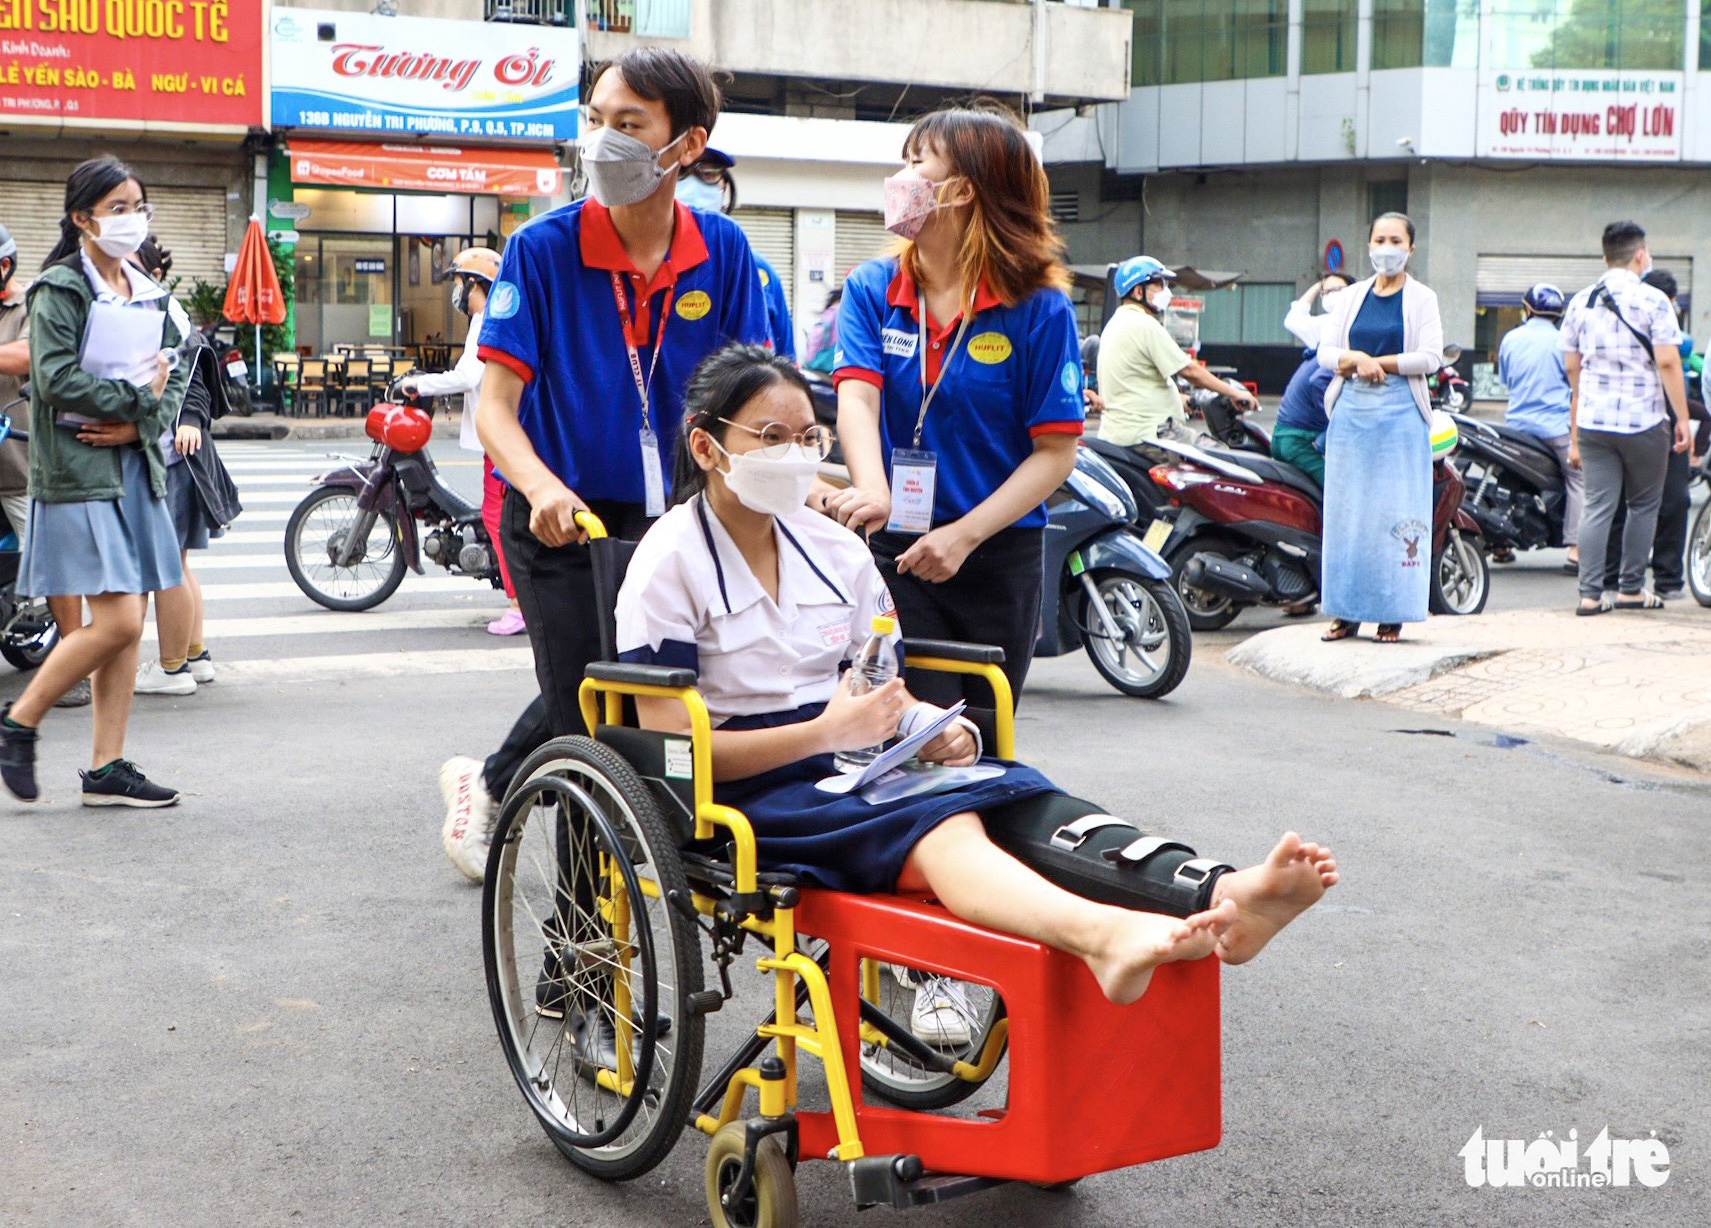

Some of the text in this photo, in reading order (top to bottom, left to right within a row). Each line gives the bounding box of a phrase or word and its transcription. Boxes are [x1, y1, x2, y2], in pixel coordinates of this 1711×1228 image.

[23, 62, 60, 86] YẾN
[64, 66, 99, 88] SÀO
[112, 67, 136, 91] BÀ
[200, 76, 218, 95] VI
[222, 74, 246, 97] CÁ
[331, 43, 482, 92] Tương
[384, 114, 404, 130] TRI
[1561, 113, 1600, 141] DỤNG
[1606, 102, 1638, 143] CHỢ
